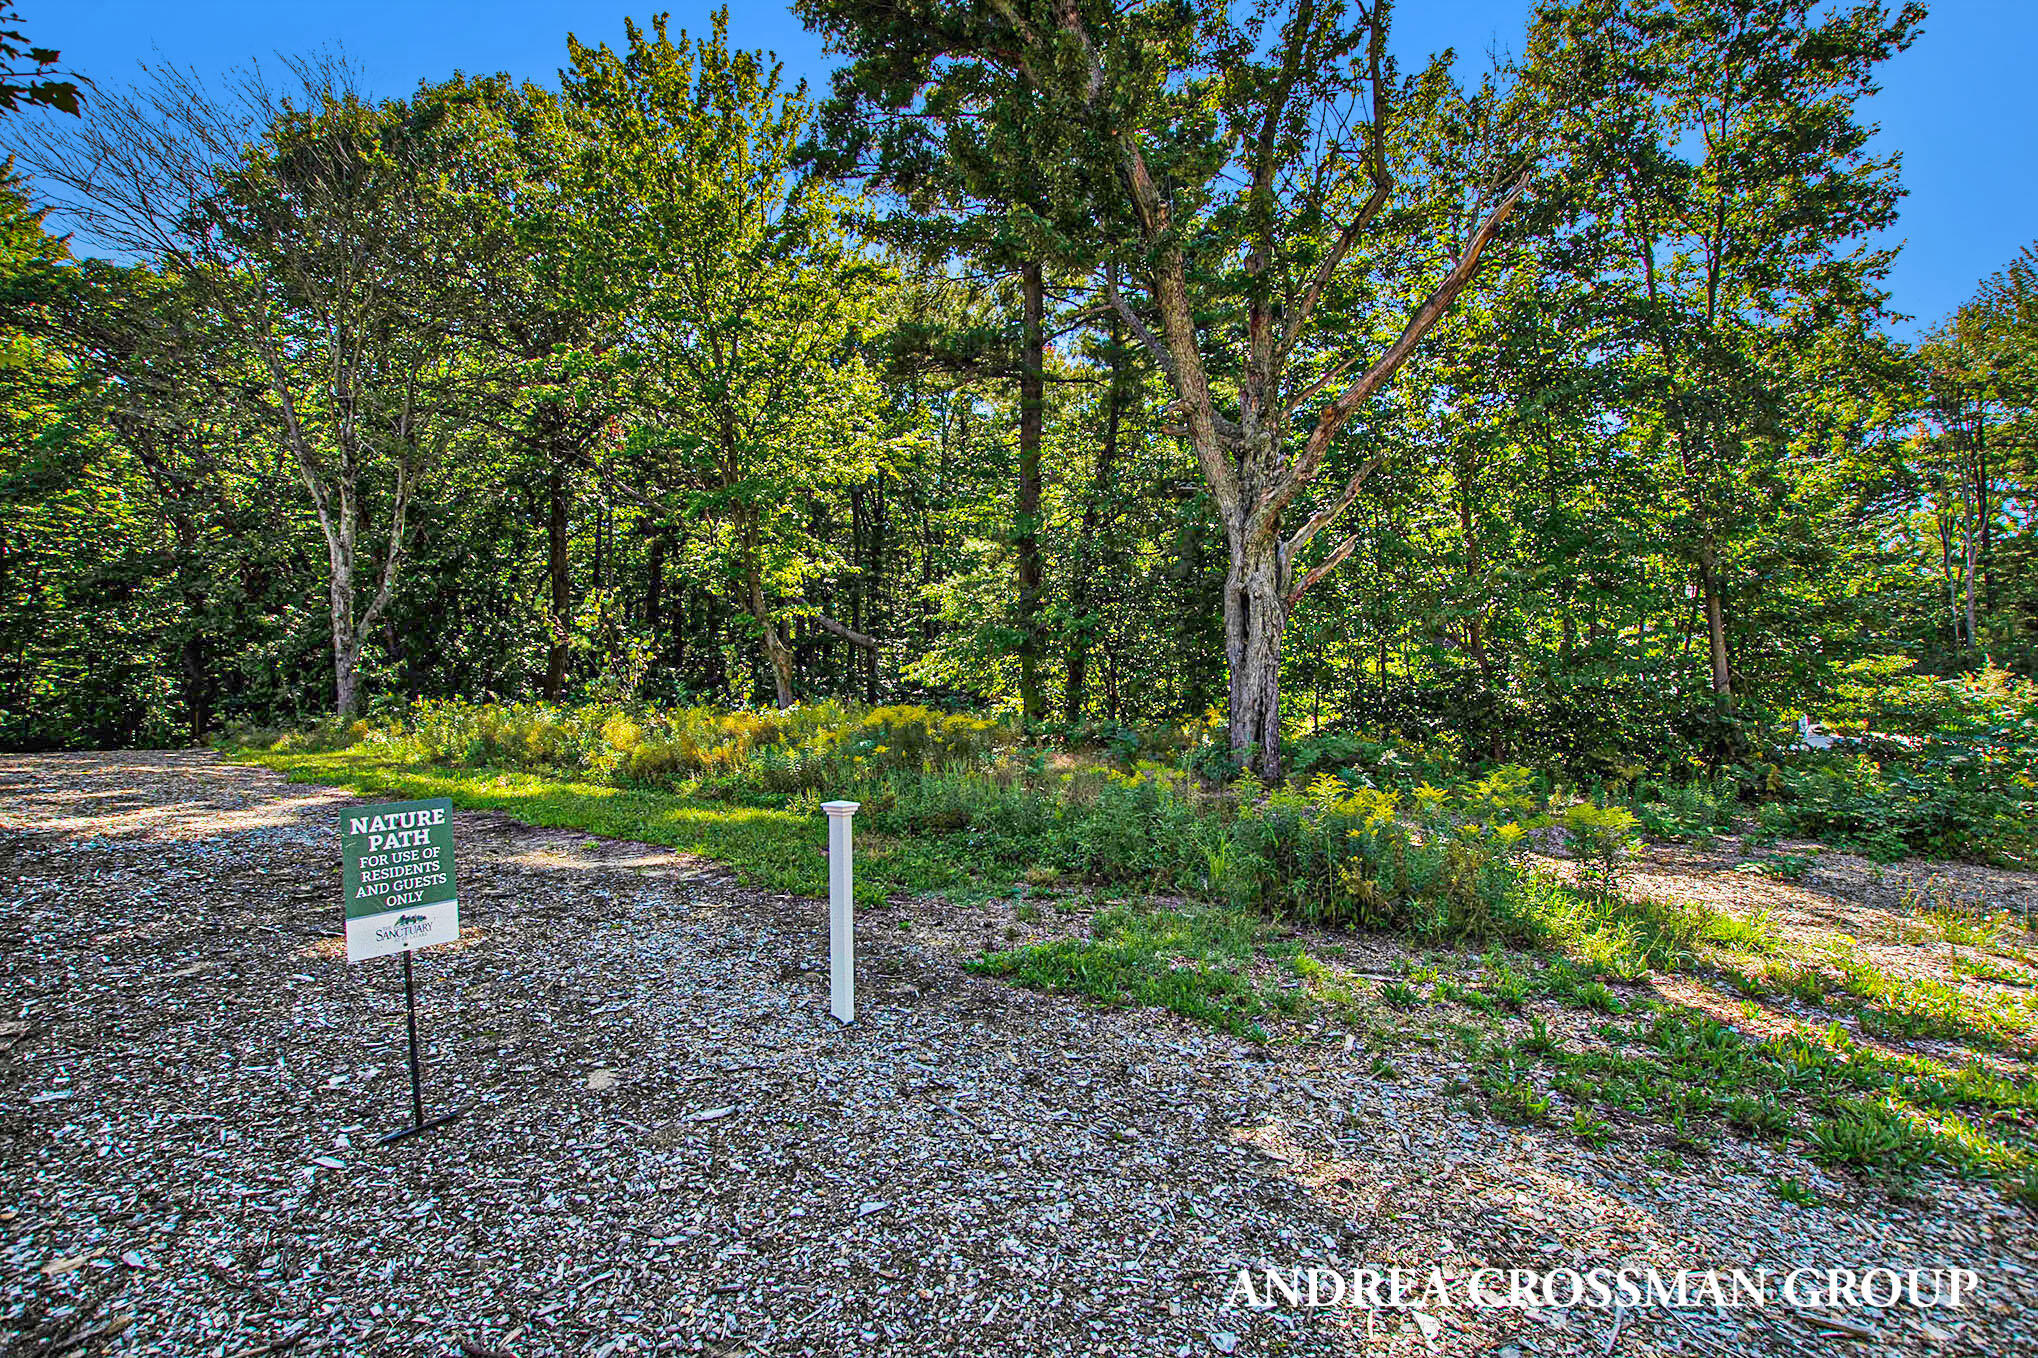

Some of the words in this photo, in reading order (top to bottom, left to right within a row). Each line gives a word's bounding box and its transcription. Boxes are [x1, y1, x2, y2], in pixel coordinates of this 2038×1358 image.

[350, 808, 446, 835] NATURE
[368, 829, 431, 852] PATH
[360, 855, 389, 869] FOR
[392, 850, 420, 864] USE
[422, 846, 441, 858] OF
[362, 860, 441, 883] RESIDENTS
[355, 883, 389, 899] AND
[393, 872, 447, 892] GUESTS
[386, 890, 425, 907] ONLY
